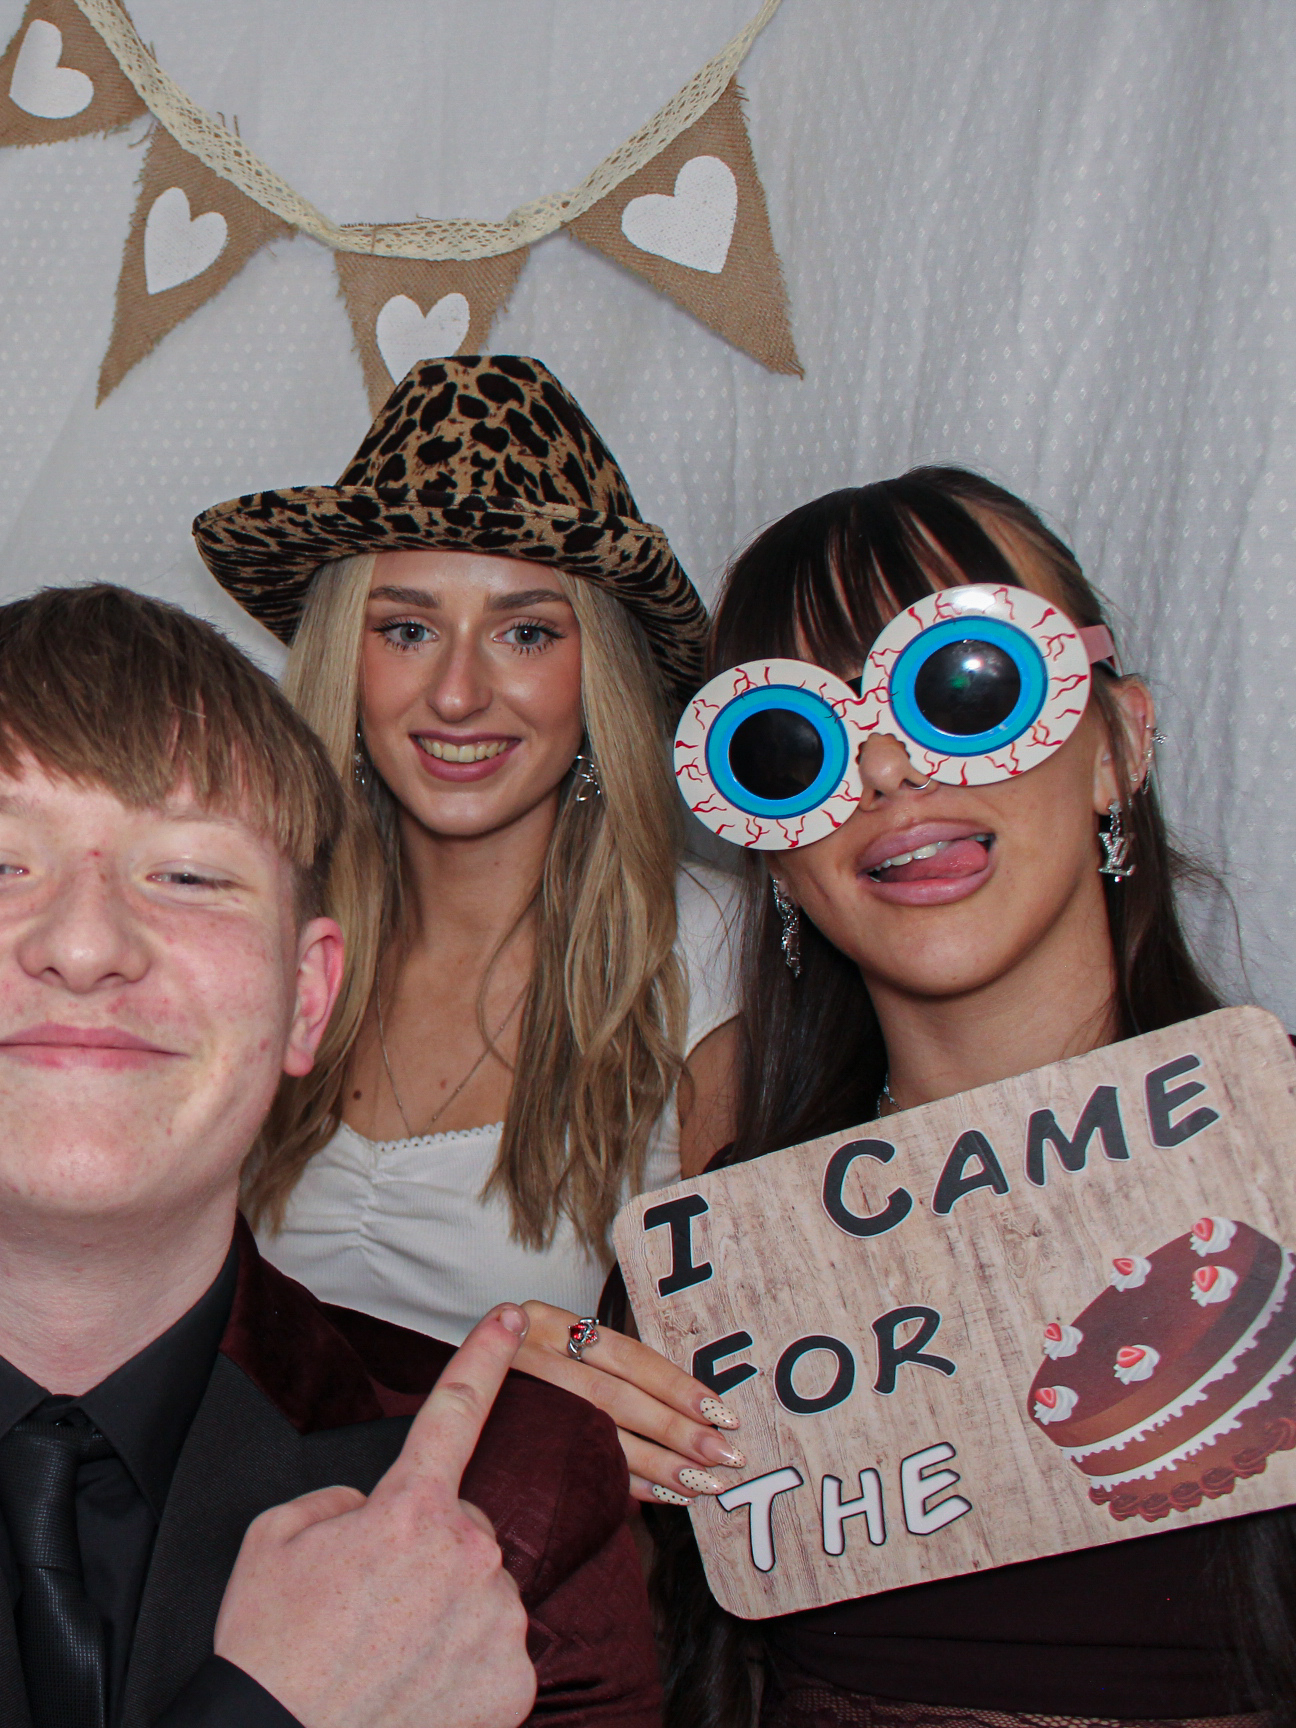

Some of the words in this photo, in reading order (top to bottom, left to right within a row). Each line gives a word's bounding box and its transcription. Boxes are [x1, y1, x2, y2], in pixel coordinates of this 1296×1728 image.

[643, 1194, 714, 1299] I
[821, 1054, 1220, 1239] CAME
[691, 1305, 958, 1418] FOR
[715, 1442, 973, 1573] THE
